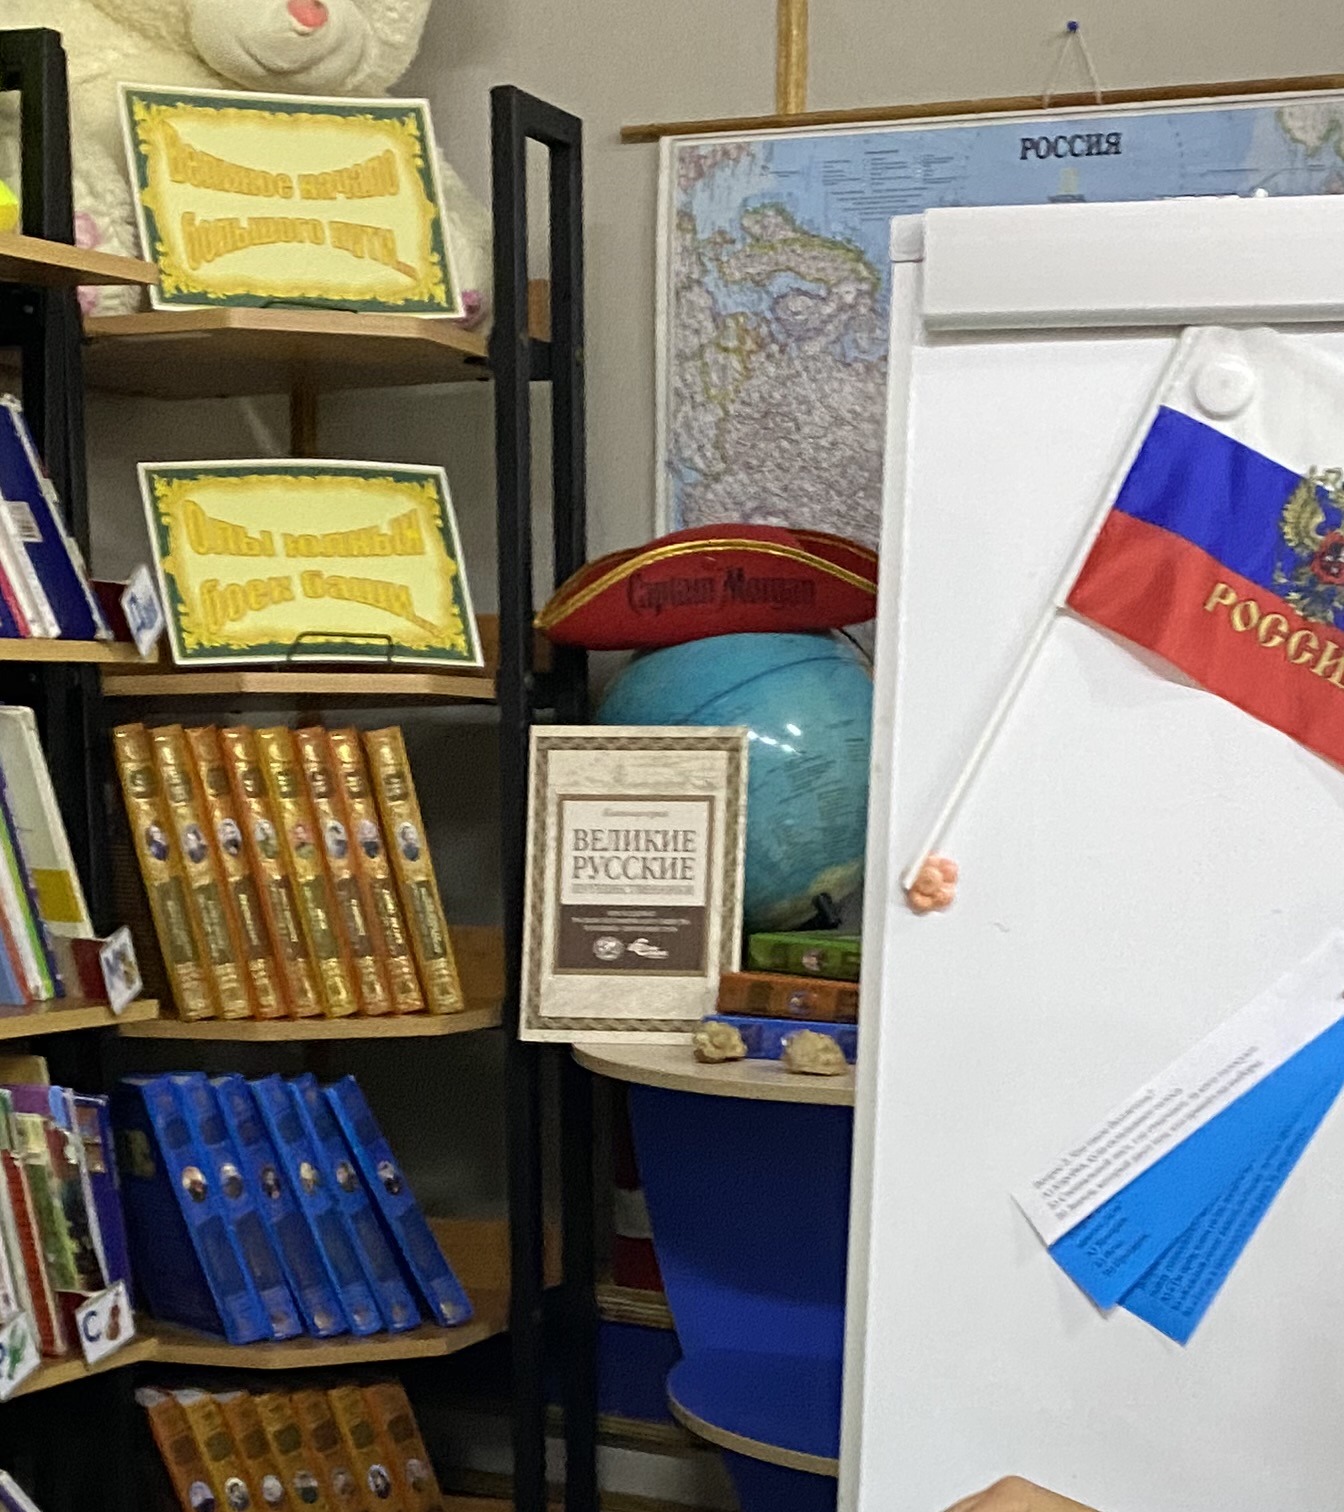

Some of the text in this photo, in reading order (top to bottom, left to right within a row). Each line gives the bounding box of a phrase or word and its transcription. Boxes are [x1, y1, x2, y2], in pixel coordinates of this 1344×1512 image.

[1020, 131, 1121, 160] РОССИЯ
[572, 828, 697, 853] ВЕЛИКИЕ
[571, 855, 696, 880] РУССКИЕ
